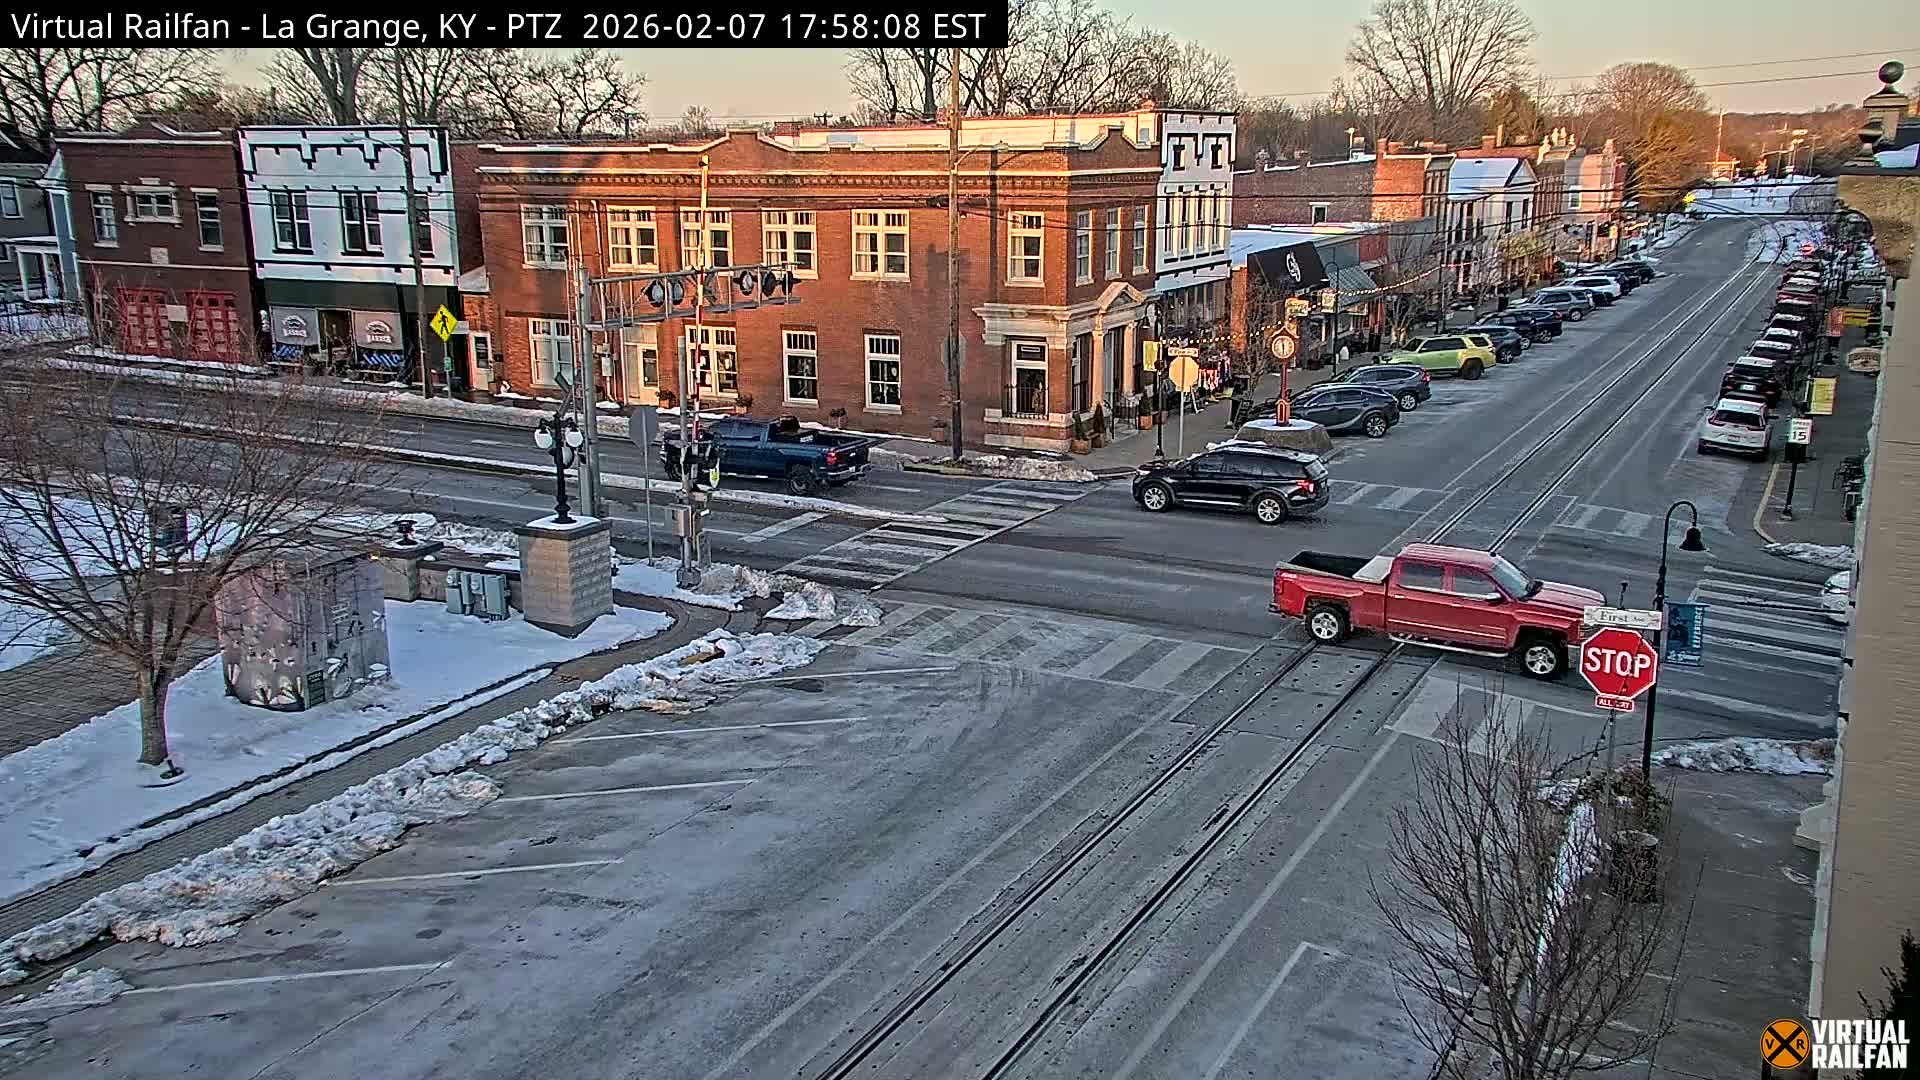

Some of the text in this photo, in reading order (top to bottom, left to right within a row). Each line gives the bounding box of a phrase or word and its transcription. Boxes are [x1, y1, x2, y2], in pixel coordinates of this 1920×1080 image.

[1792, 431, 1807, 441] 15
[1600, 610, 1629, 622] First
[1585, 647, 1651, 678] STOP
[1599, 698, 1613, 707] ALL
